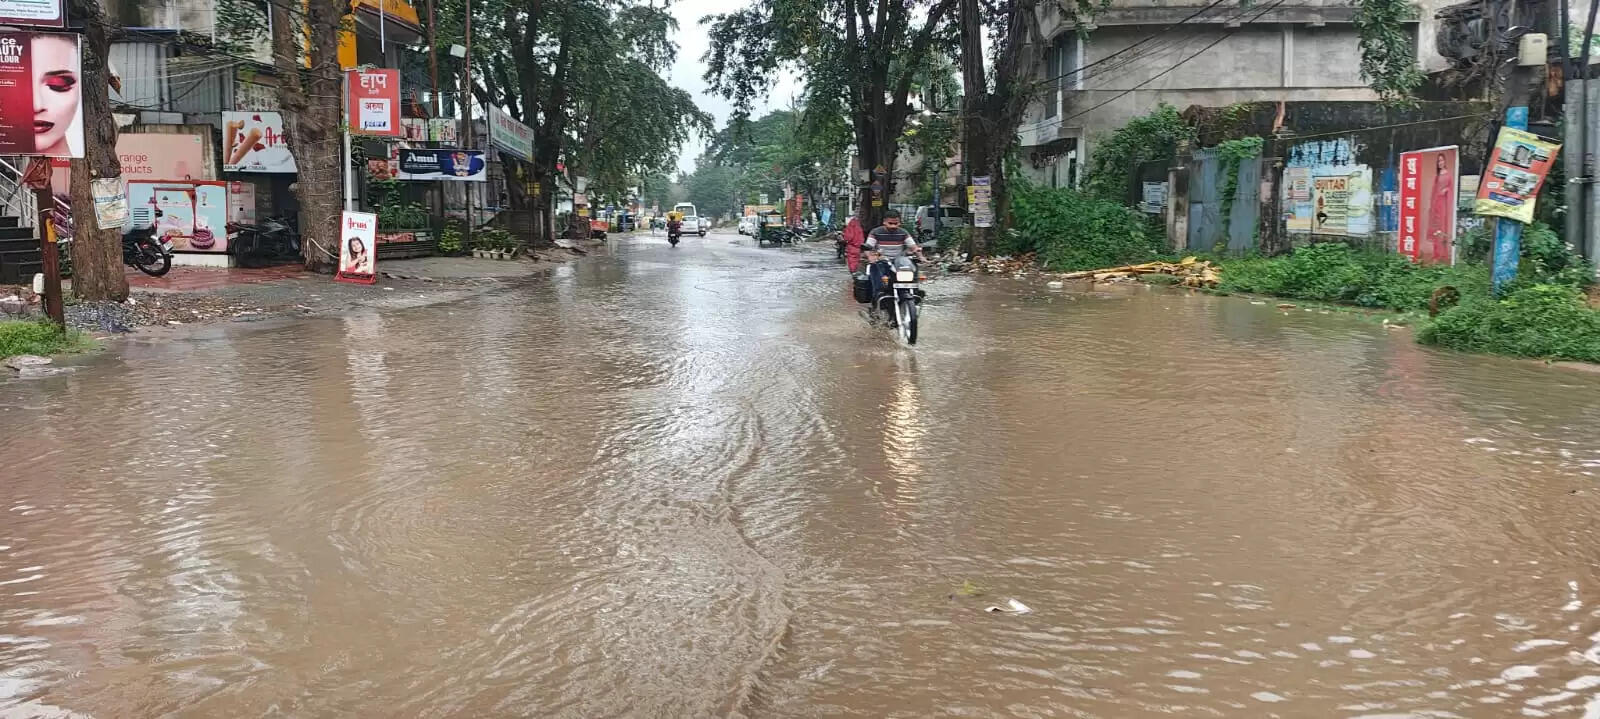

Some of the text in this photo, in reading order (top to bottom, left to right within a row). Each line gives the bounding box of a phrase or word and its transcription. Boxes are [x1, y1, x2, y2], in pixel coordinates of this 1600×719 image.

[359, 73, 387, 88] हाप
[119, 154, 148, 162] range
[406, 152, 438, 163] Amul
[1315, 178, 1345, 190] GUITAR
